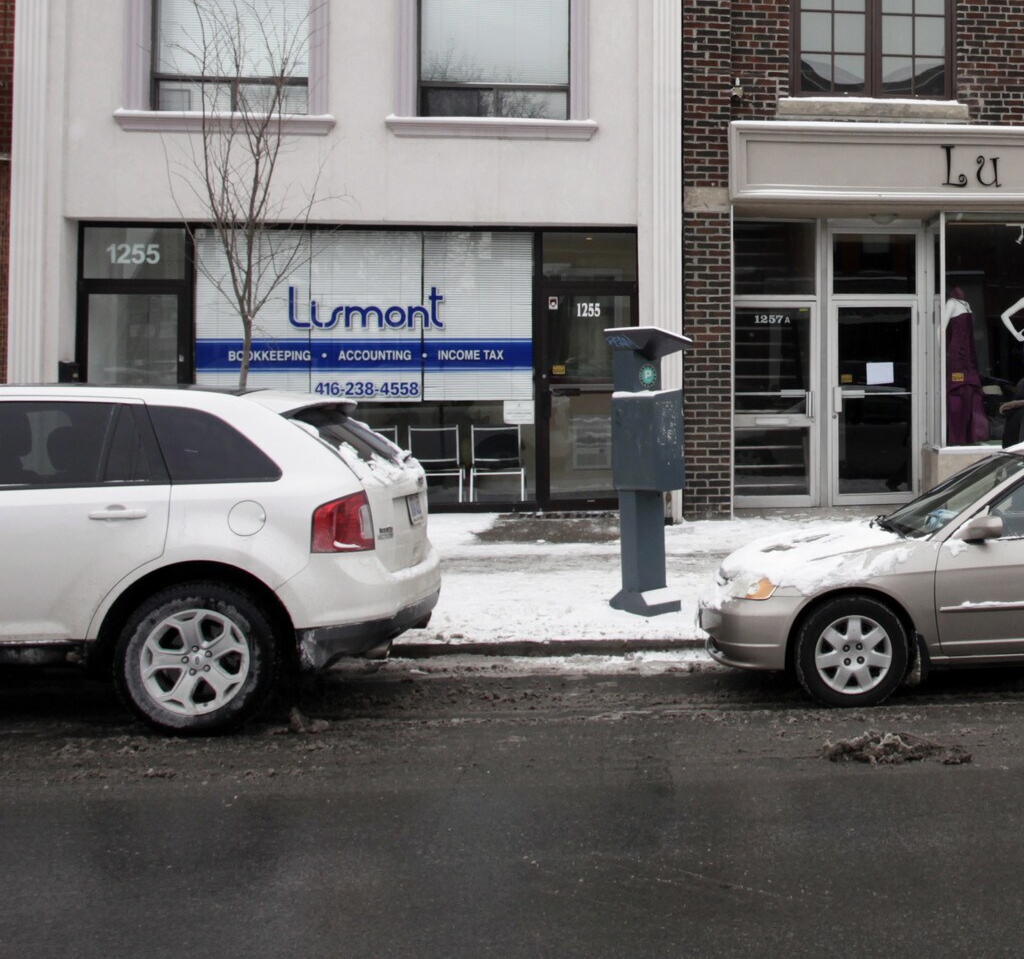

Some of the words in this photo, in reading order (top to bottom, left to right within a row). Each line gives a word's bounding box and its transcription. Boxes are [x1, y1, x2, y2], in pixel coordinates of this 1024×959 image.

[941, 145, 1002, 188] Lu
[106, 244, 161, 264] 1255
[288, 286, 444, 329] Lismont
[576, 302, 601, 317] 1255
[228, 350, 311, 361] BOOKKEEPING
[338, 350, 412, 361] ACCOUNTING
[437, 350, 481, 360] INCOME
[483, 350, 504, 360] TAX
[314, 382, 420, 397] 416-238-4558
